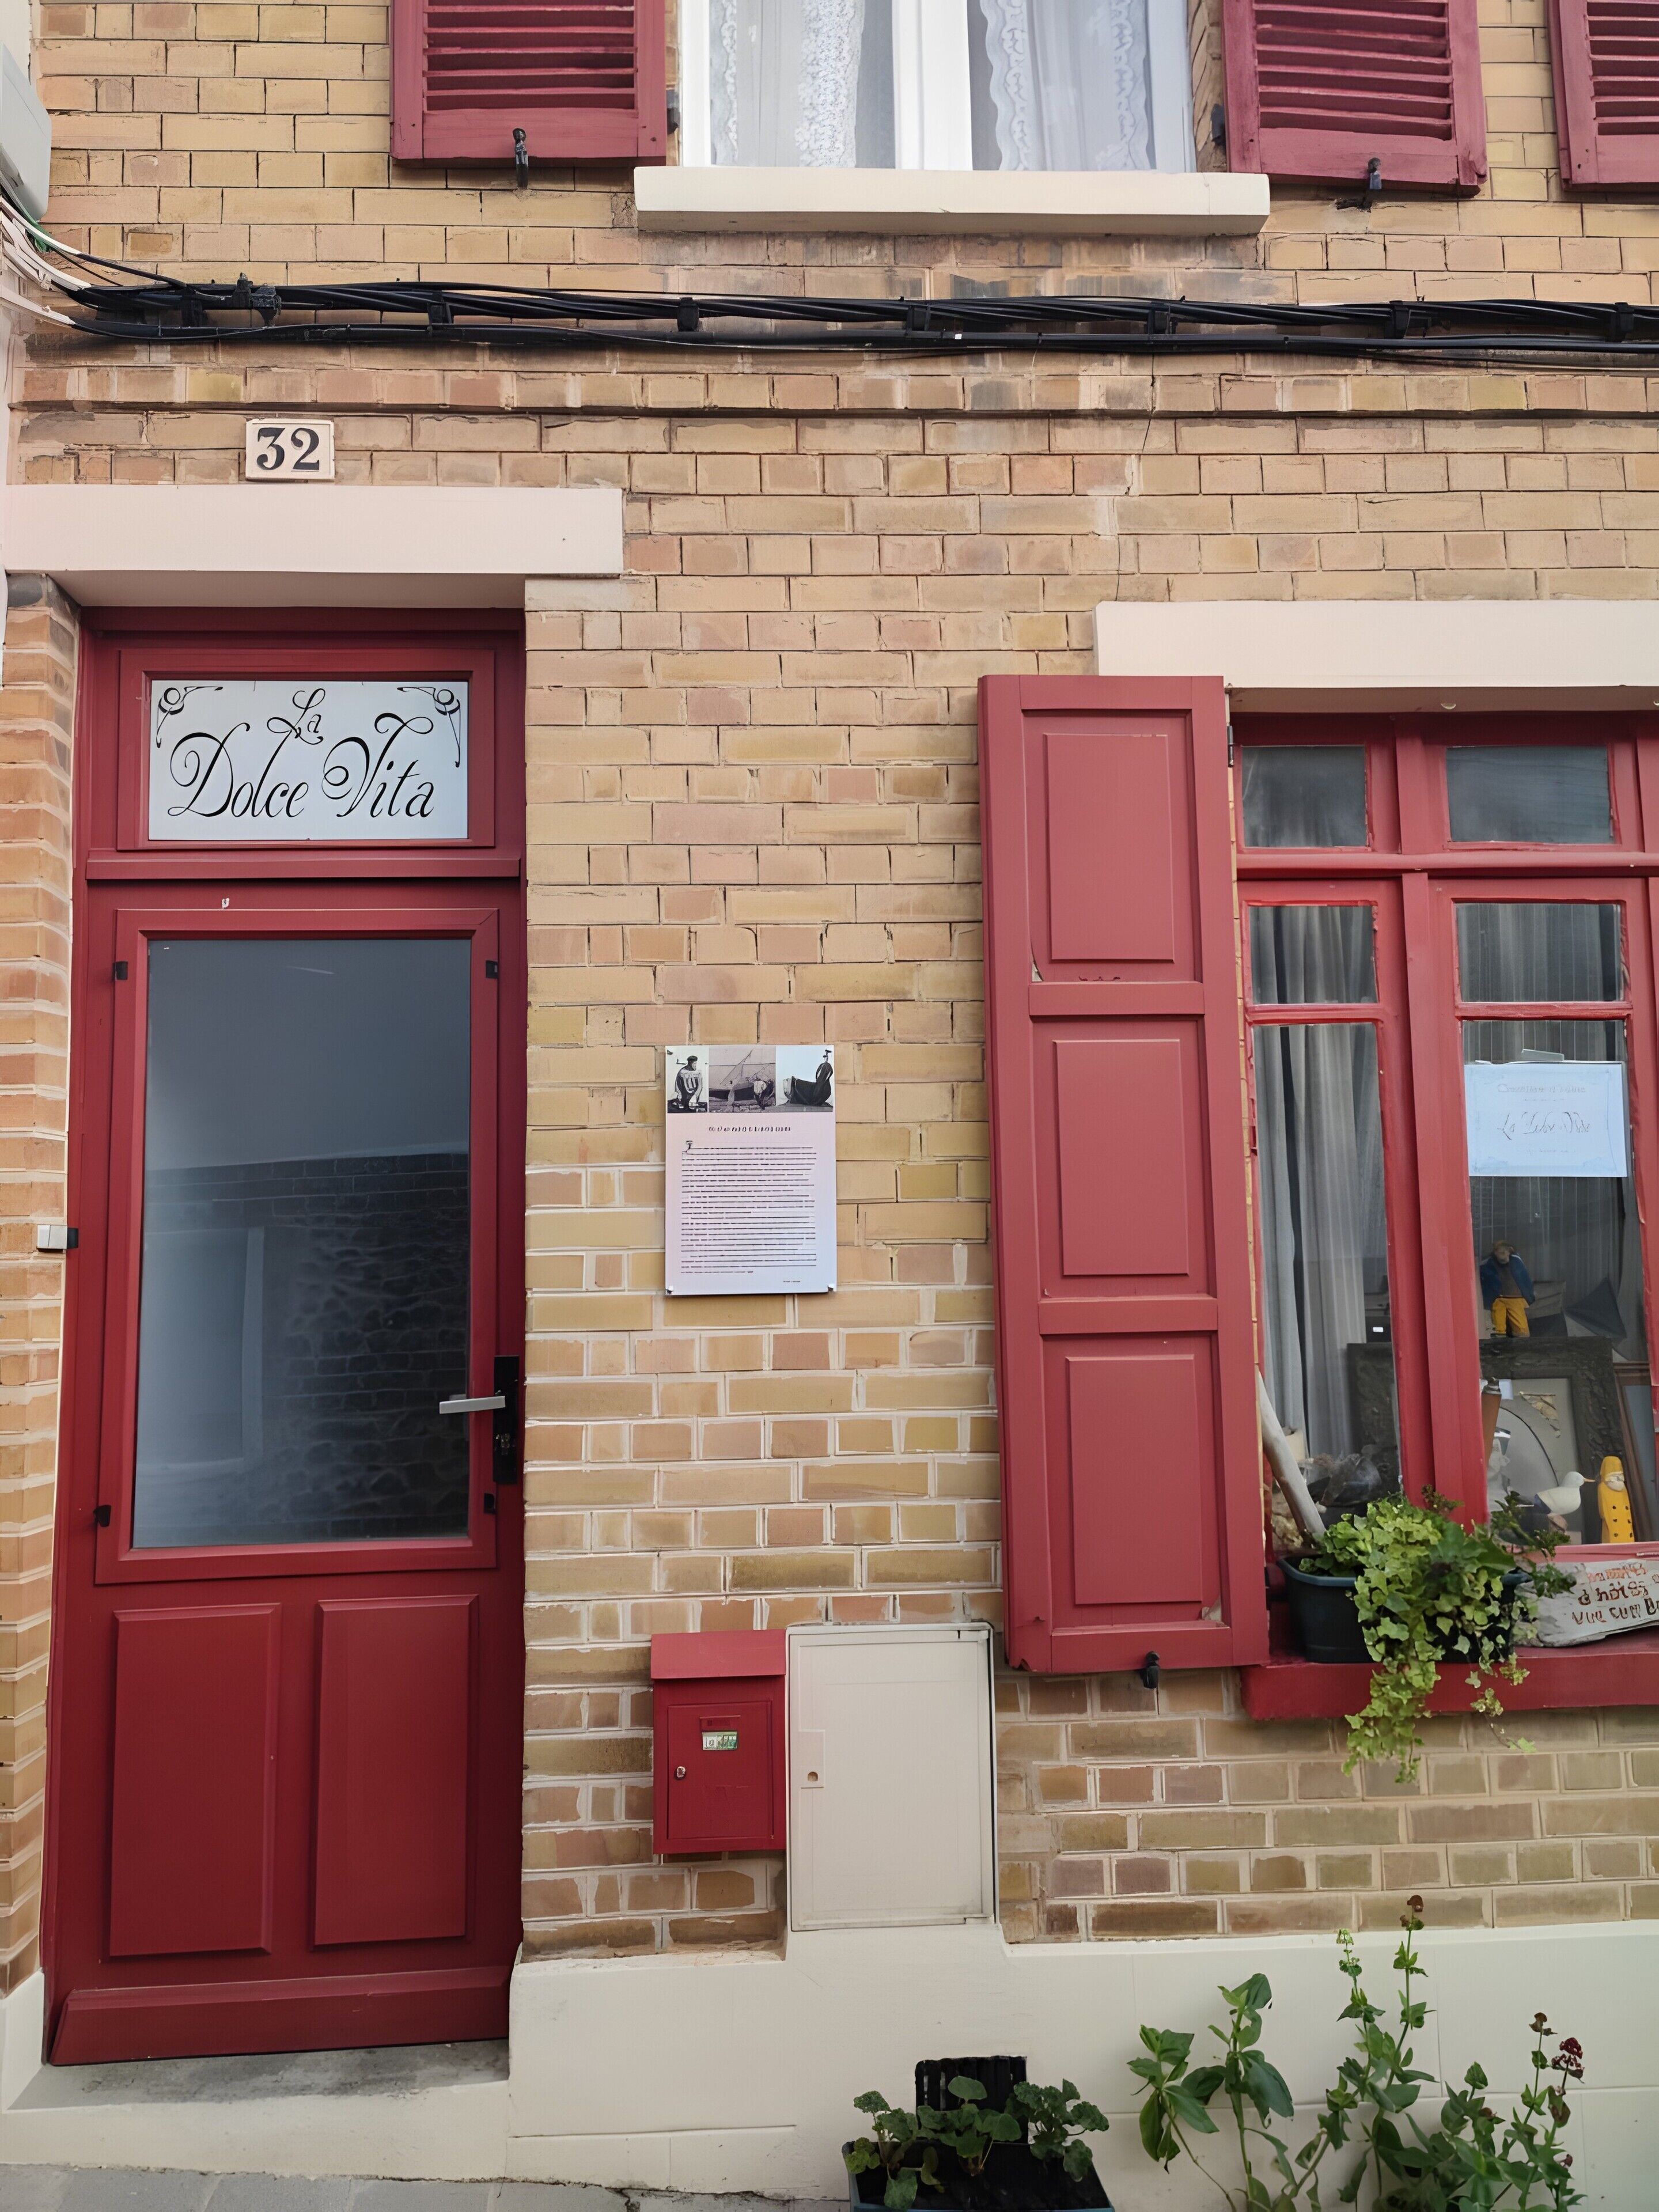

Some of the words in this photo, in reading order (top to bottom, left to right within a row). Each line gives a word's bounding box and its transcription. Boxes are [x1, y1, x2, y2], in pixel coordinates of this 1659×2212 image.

[256, 427, 320, 471] 32
[266, 688, 326, 745] La
[167, 722, 309, 818] Dolce
[321, 712, 434, 818] Vita
